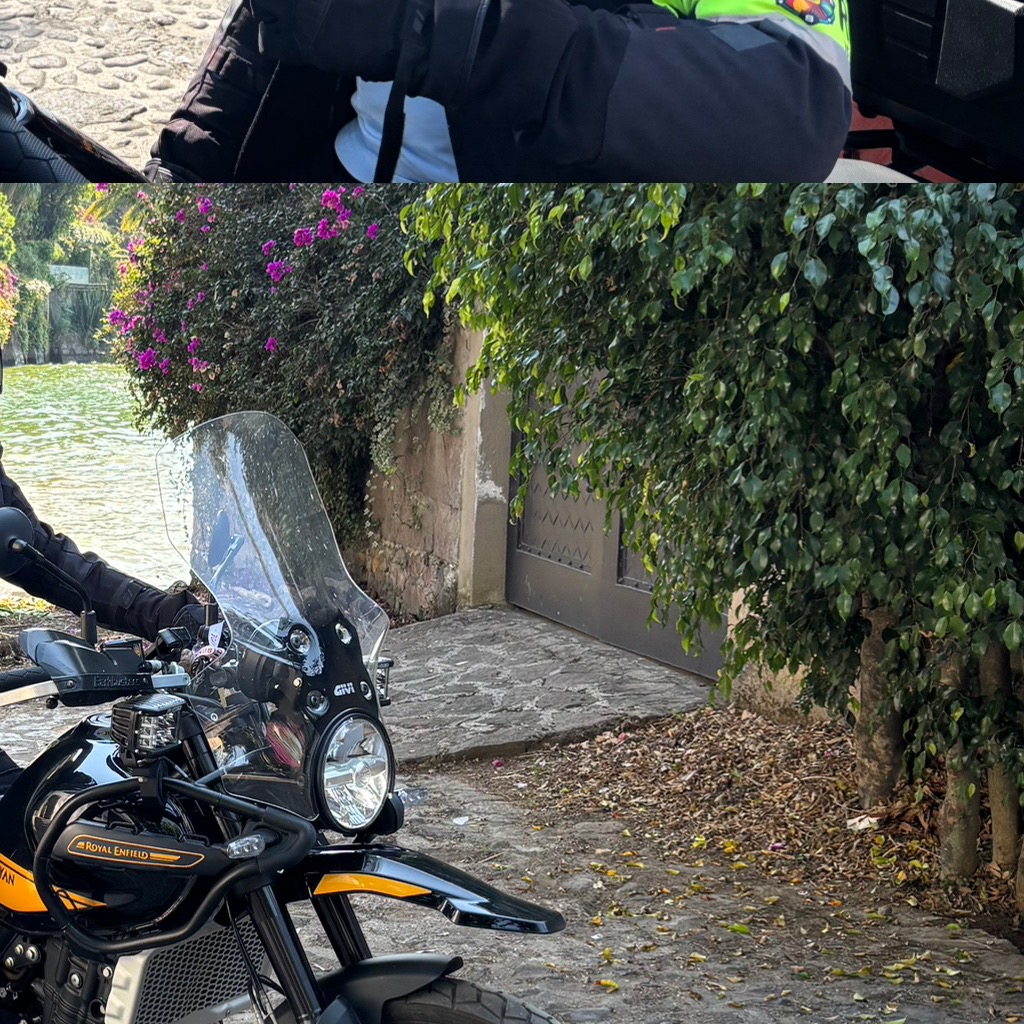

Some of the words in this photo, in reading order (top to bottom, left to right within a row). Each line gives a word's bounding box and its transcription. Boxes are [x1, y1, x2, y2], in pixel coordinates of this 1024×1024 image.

[334, 681, 355, 697] GIVI
[85, 841, 112, 854] ROYAL
[114, 845, 149, 860] ENFIELD
